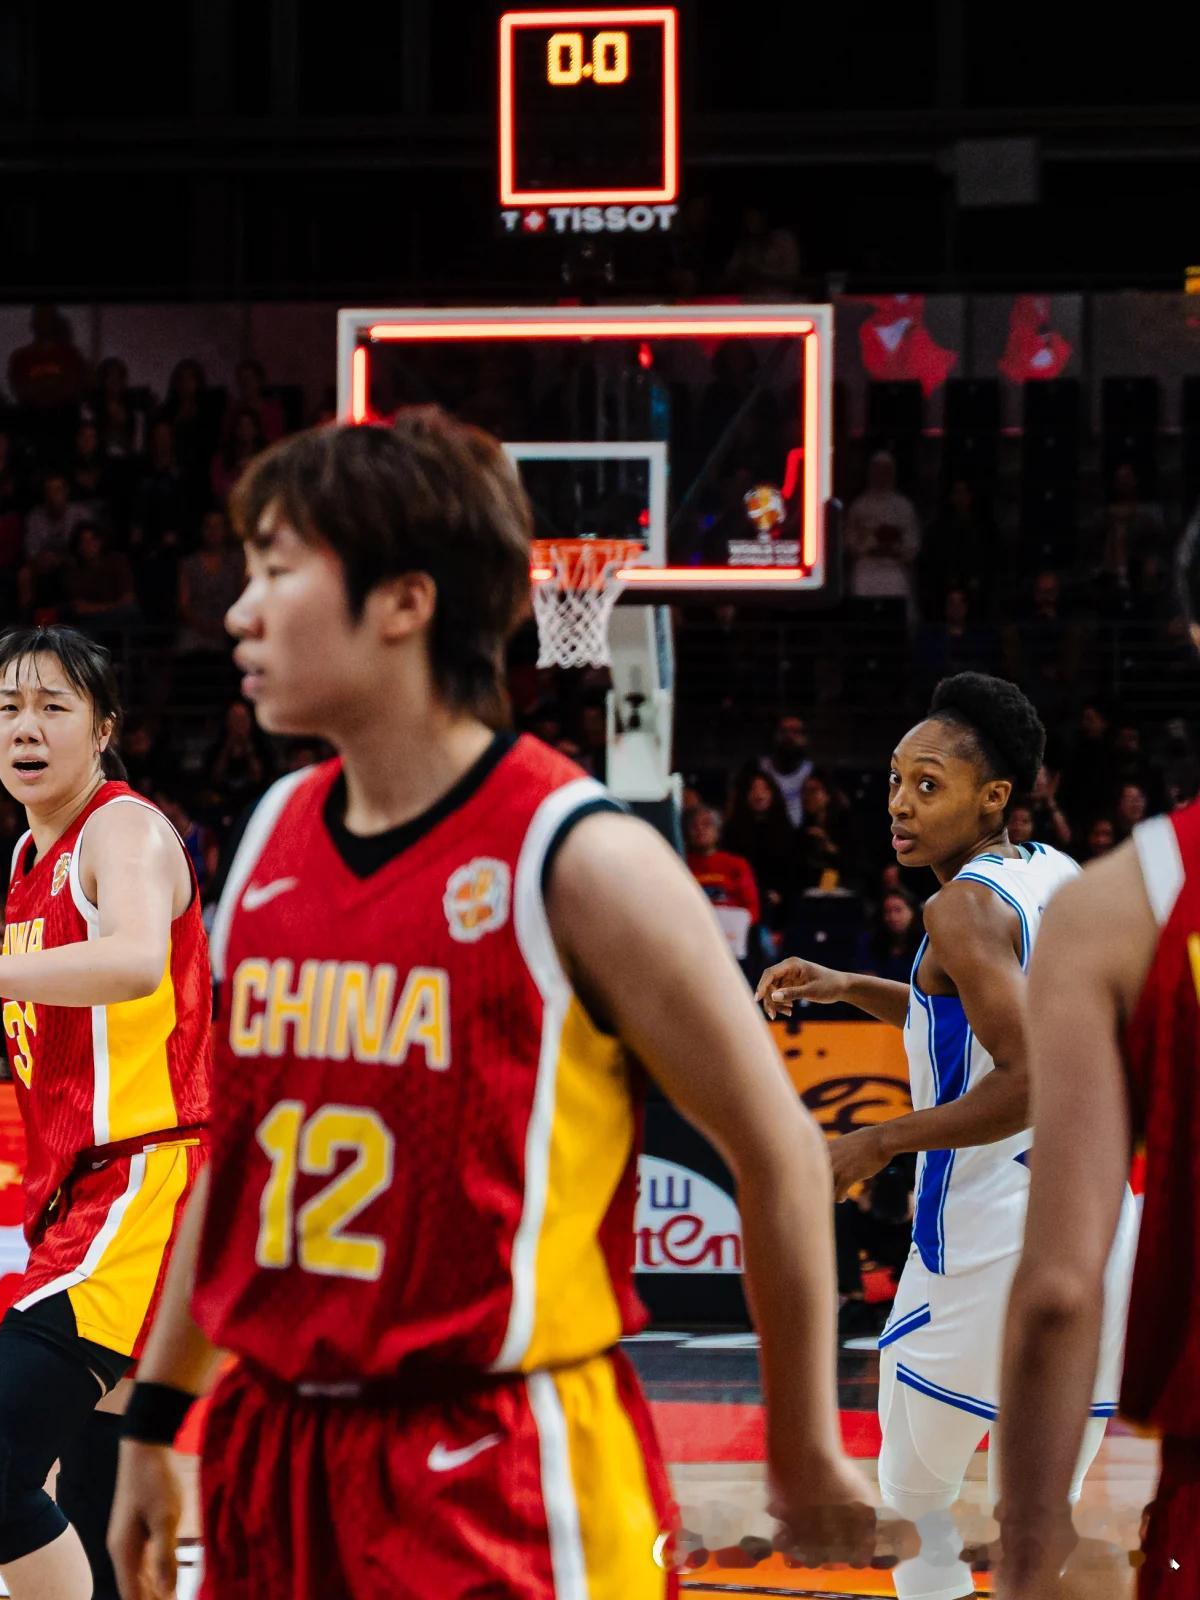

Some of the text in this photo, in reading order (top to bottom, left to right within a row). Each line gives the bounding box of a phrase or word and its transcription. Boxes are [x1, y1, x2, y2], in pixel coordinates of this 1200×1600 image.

[547, 32, 629, 85] 0.0
[548, 204, 678, 233] TISSOT
[229, 957, 452, 1072] CHINA
[255, 1099, 395, 1282] 12
